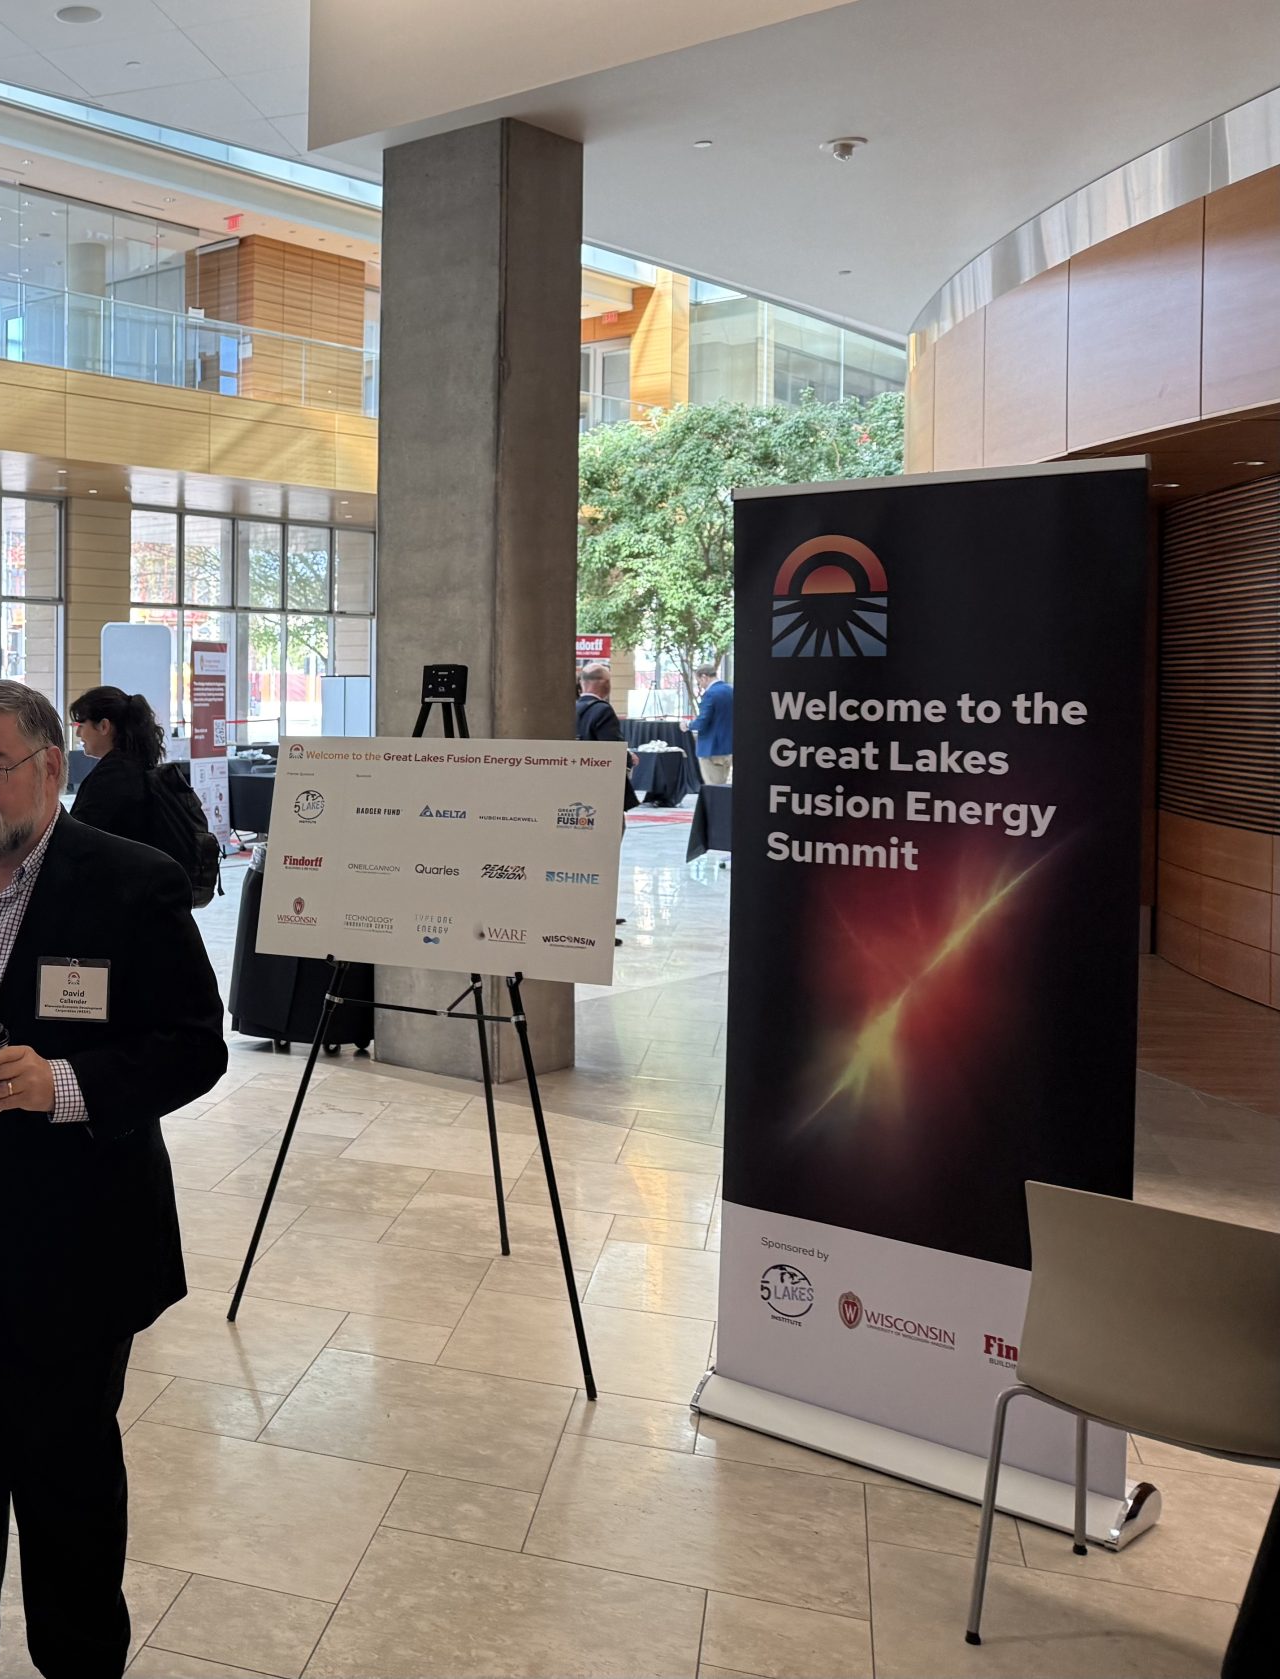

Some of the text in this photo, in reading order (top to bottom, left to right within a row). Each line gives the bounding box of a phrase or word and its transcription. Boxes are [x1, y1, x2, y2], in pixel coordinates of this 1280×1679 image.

[770, 691, 1088, 725] Welcome to the
[306, 751, 350, 761] Welcome
[352, 752, 362, 761] to
[365, 751, 381, 761] the
[383, 752, 413, 762] Great
[414, 753, 445, 763] Lakes
[446, 754, 481, 764] Fusion
[483, 755, 522, 767] Energy
[524, 756, 568, 766] Summit
[580, 757, 612, 768] Mixer
[769, 738, 1009, 775] Great Lakes
[294, 800, 325, 814] 5 LAKES
[384, 808, 401, 816] FUND
[435, 809, 467, 819] DELTA
[769, 784, 1057, 838] Fusion Energy
[557, 816, 595, 826] FUSION
[766, 831, 919, 871] Summit
[283, 855, 323, 867] Findorff
[415, 863, 460, 876] Quarles
[481, 871, 524, 880] FUSION
[556, 872, 599, 884] SHINE
[277, 914, 317, 924] WISCONSIN
[487, 927, 527, 941] WARF
[542, 935, 596, 947] WISCONSIN
[62, 989, 85, 998] David
[761, 1236, 829, 1262] Sponsored by
[760, 1280, 814, 1302] 5 LAKES
[843, 1302, 858, 1320] W
[864, 1309, 956, 1346] WISCONSIN
